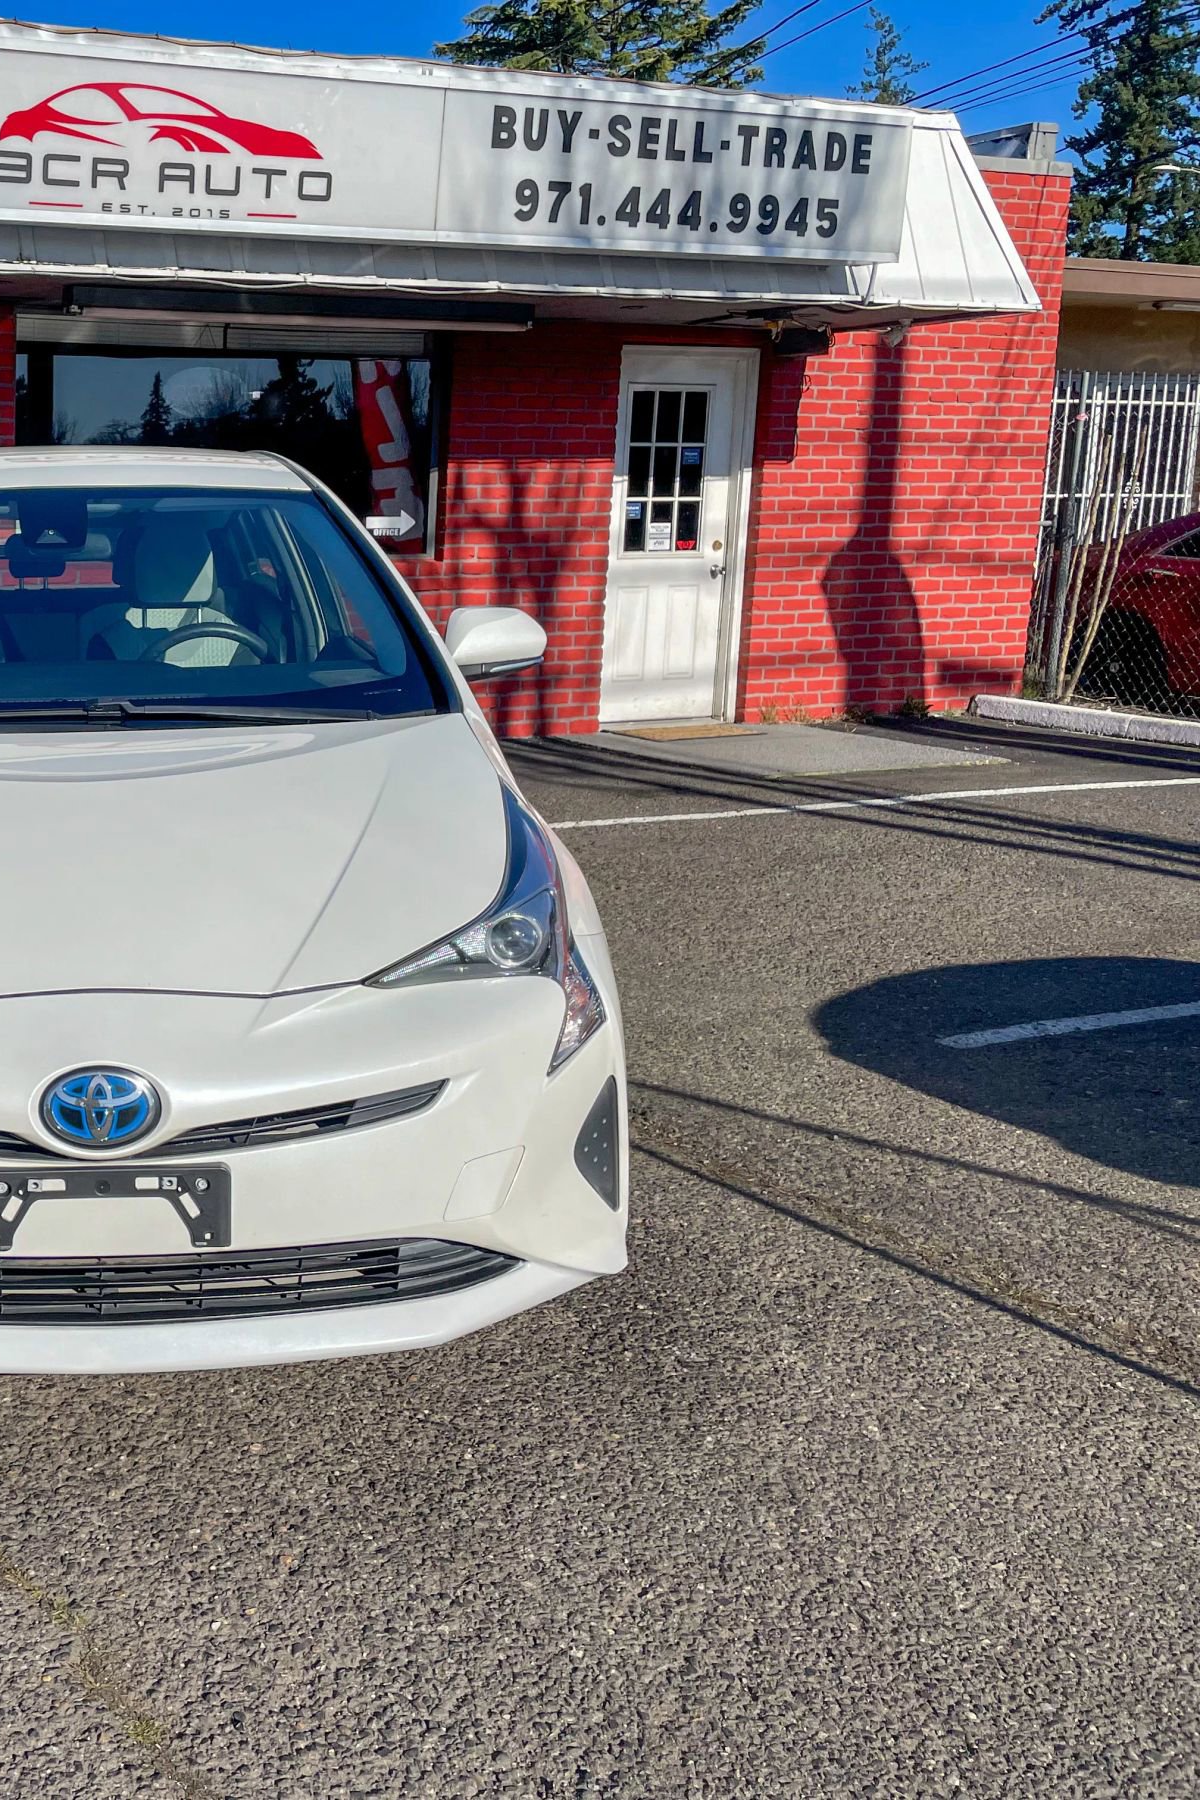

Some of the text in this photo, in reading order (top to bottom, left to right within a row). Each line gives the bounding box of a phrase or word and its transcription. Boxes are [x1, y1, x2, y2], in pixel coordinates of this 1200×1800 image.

[158, 162, 332, 202] AUTO
[101, 202, 231, 219] EST. 2015
[514, 178, 841, 239] 971.444.9945
[373, 528, 399, 536] OFFICE
